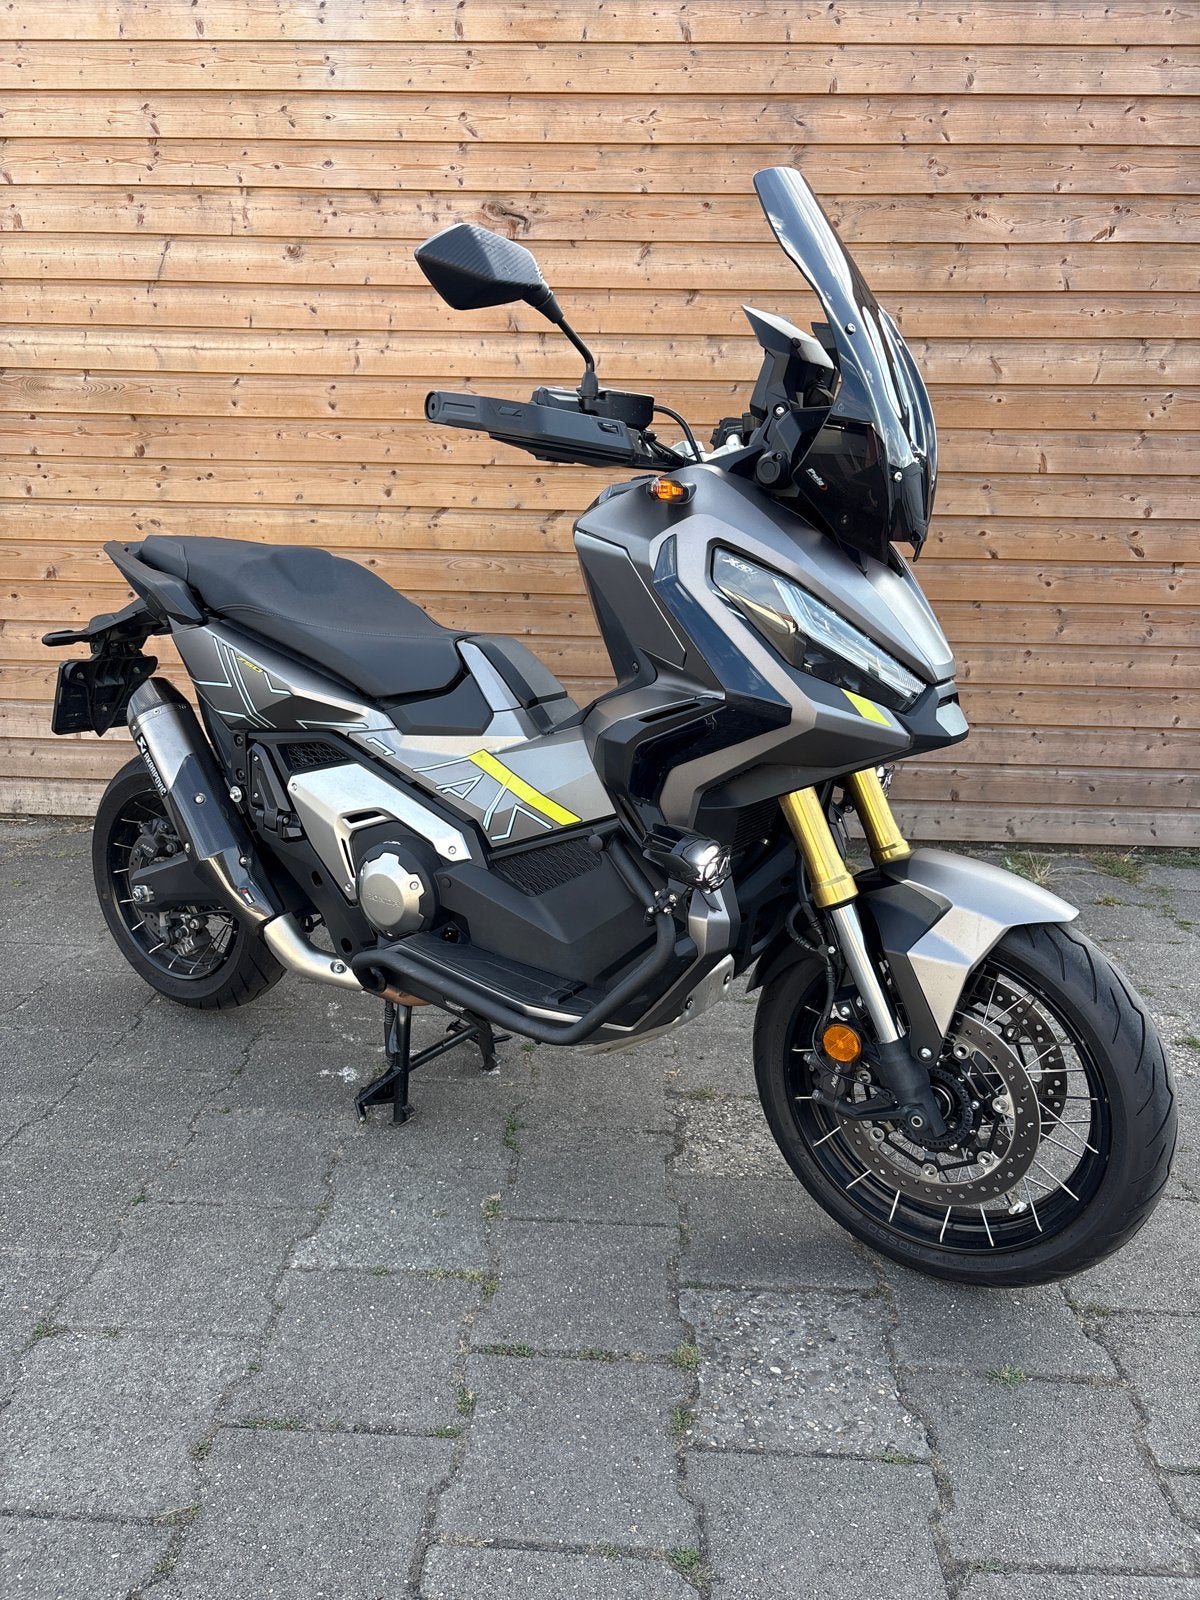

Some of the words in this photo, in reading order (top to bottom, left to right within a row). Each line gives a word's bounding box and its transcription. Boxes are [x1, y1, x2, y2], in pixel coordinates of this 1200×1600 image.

[806, 468, 825, 486] Puig
[236, 656, 263, 673] 750
[868, 1223, 920, 1255] ROSSO
